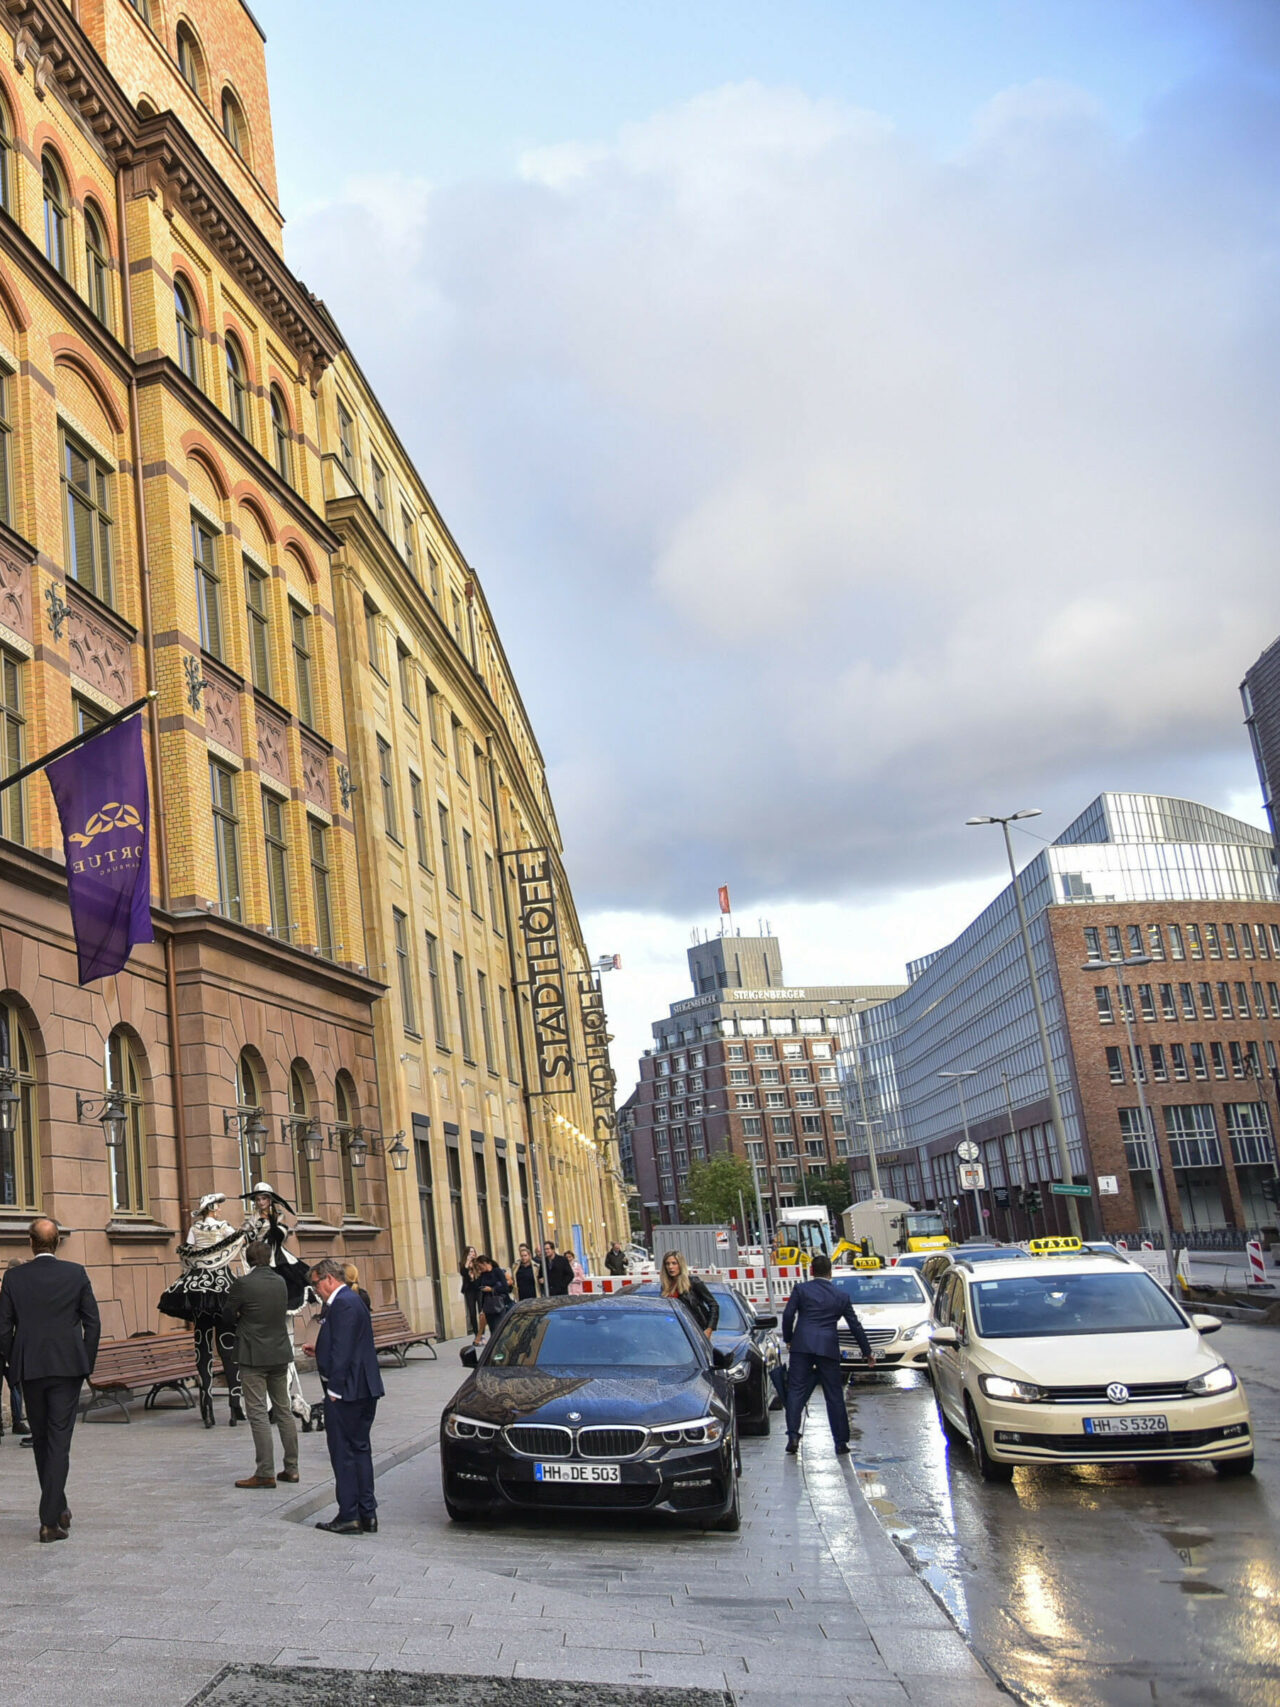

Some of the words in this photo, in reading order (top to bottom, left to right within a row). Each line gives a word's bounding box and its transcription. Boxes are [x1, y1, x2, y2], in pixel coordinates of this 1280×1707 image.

[519, 861, 569, 1078] STADTHÖFE
[673, 994, 717, 1014] STEIGENBERGER
[733, 990, 805, 1000] STEIGENBERGER
[1037, 1239, 1073, 1249] TAXI
[1092, 1420, 1111, 1431] HH
[1120, 1419, 1129, 1431] S
[1131, 1418, 1165, 1430] 5326
[543, 1466, 561, 1479] HH
[570, 1467, 589, 1480] DE
[591, 1468, 618, 1481] 503
